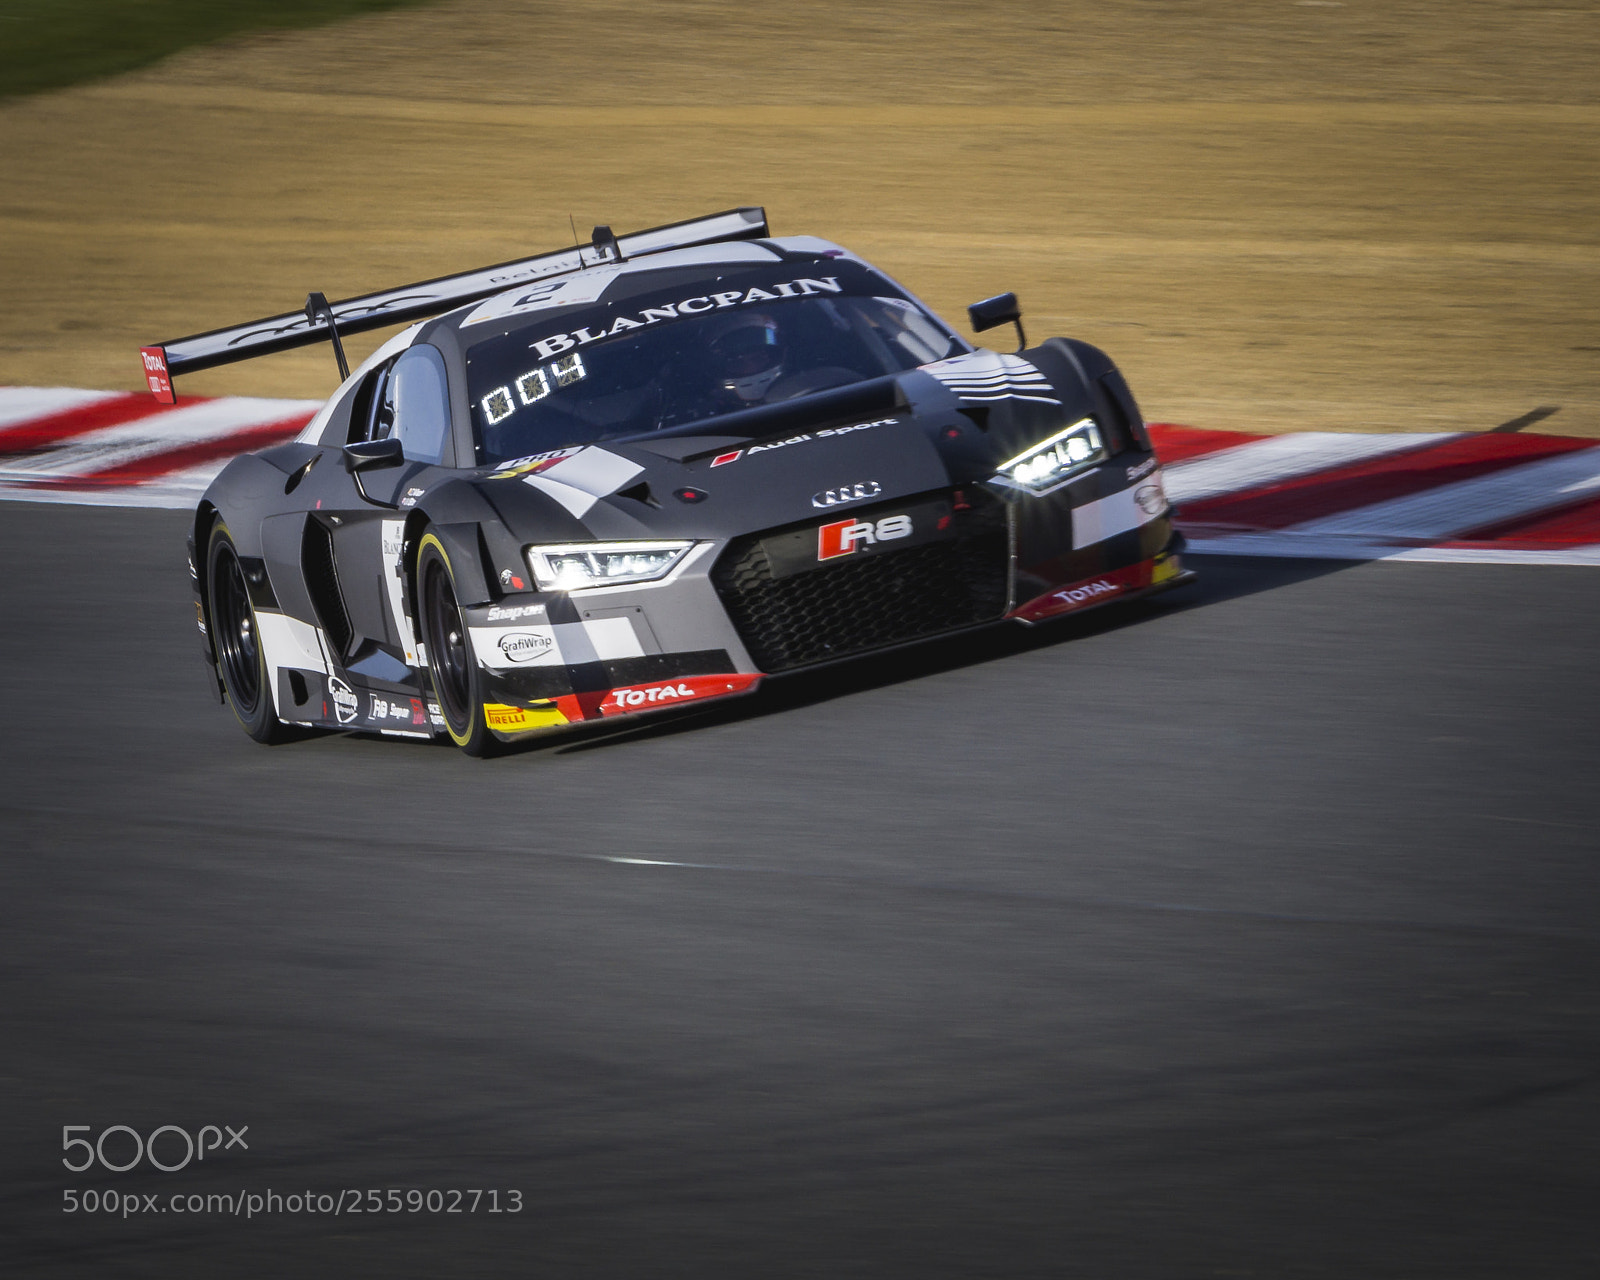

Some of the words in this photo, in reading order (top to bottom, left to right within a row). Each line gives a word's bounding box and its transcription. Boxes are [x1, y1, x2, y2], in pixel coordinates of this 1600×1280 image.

[528, 276, 843, 360] BLANCPAIN
[141, 351, 166, 371] TOTAL
[481, 352, 588, 425] 004
[747, 433, 812, 456] Audi
[815, 417, 900, 438] Sport
[510, 450, 567, 467] PRO
[840, 514, 914, 551] R8
[1053, 580, 1119, 604] TOTAL
[487, 604, 547, 621] Snap-on
[501, 637, 553, 653] GrafiWrap
[611, 683, 695, 707] TOTAL
